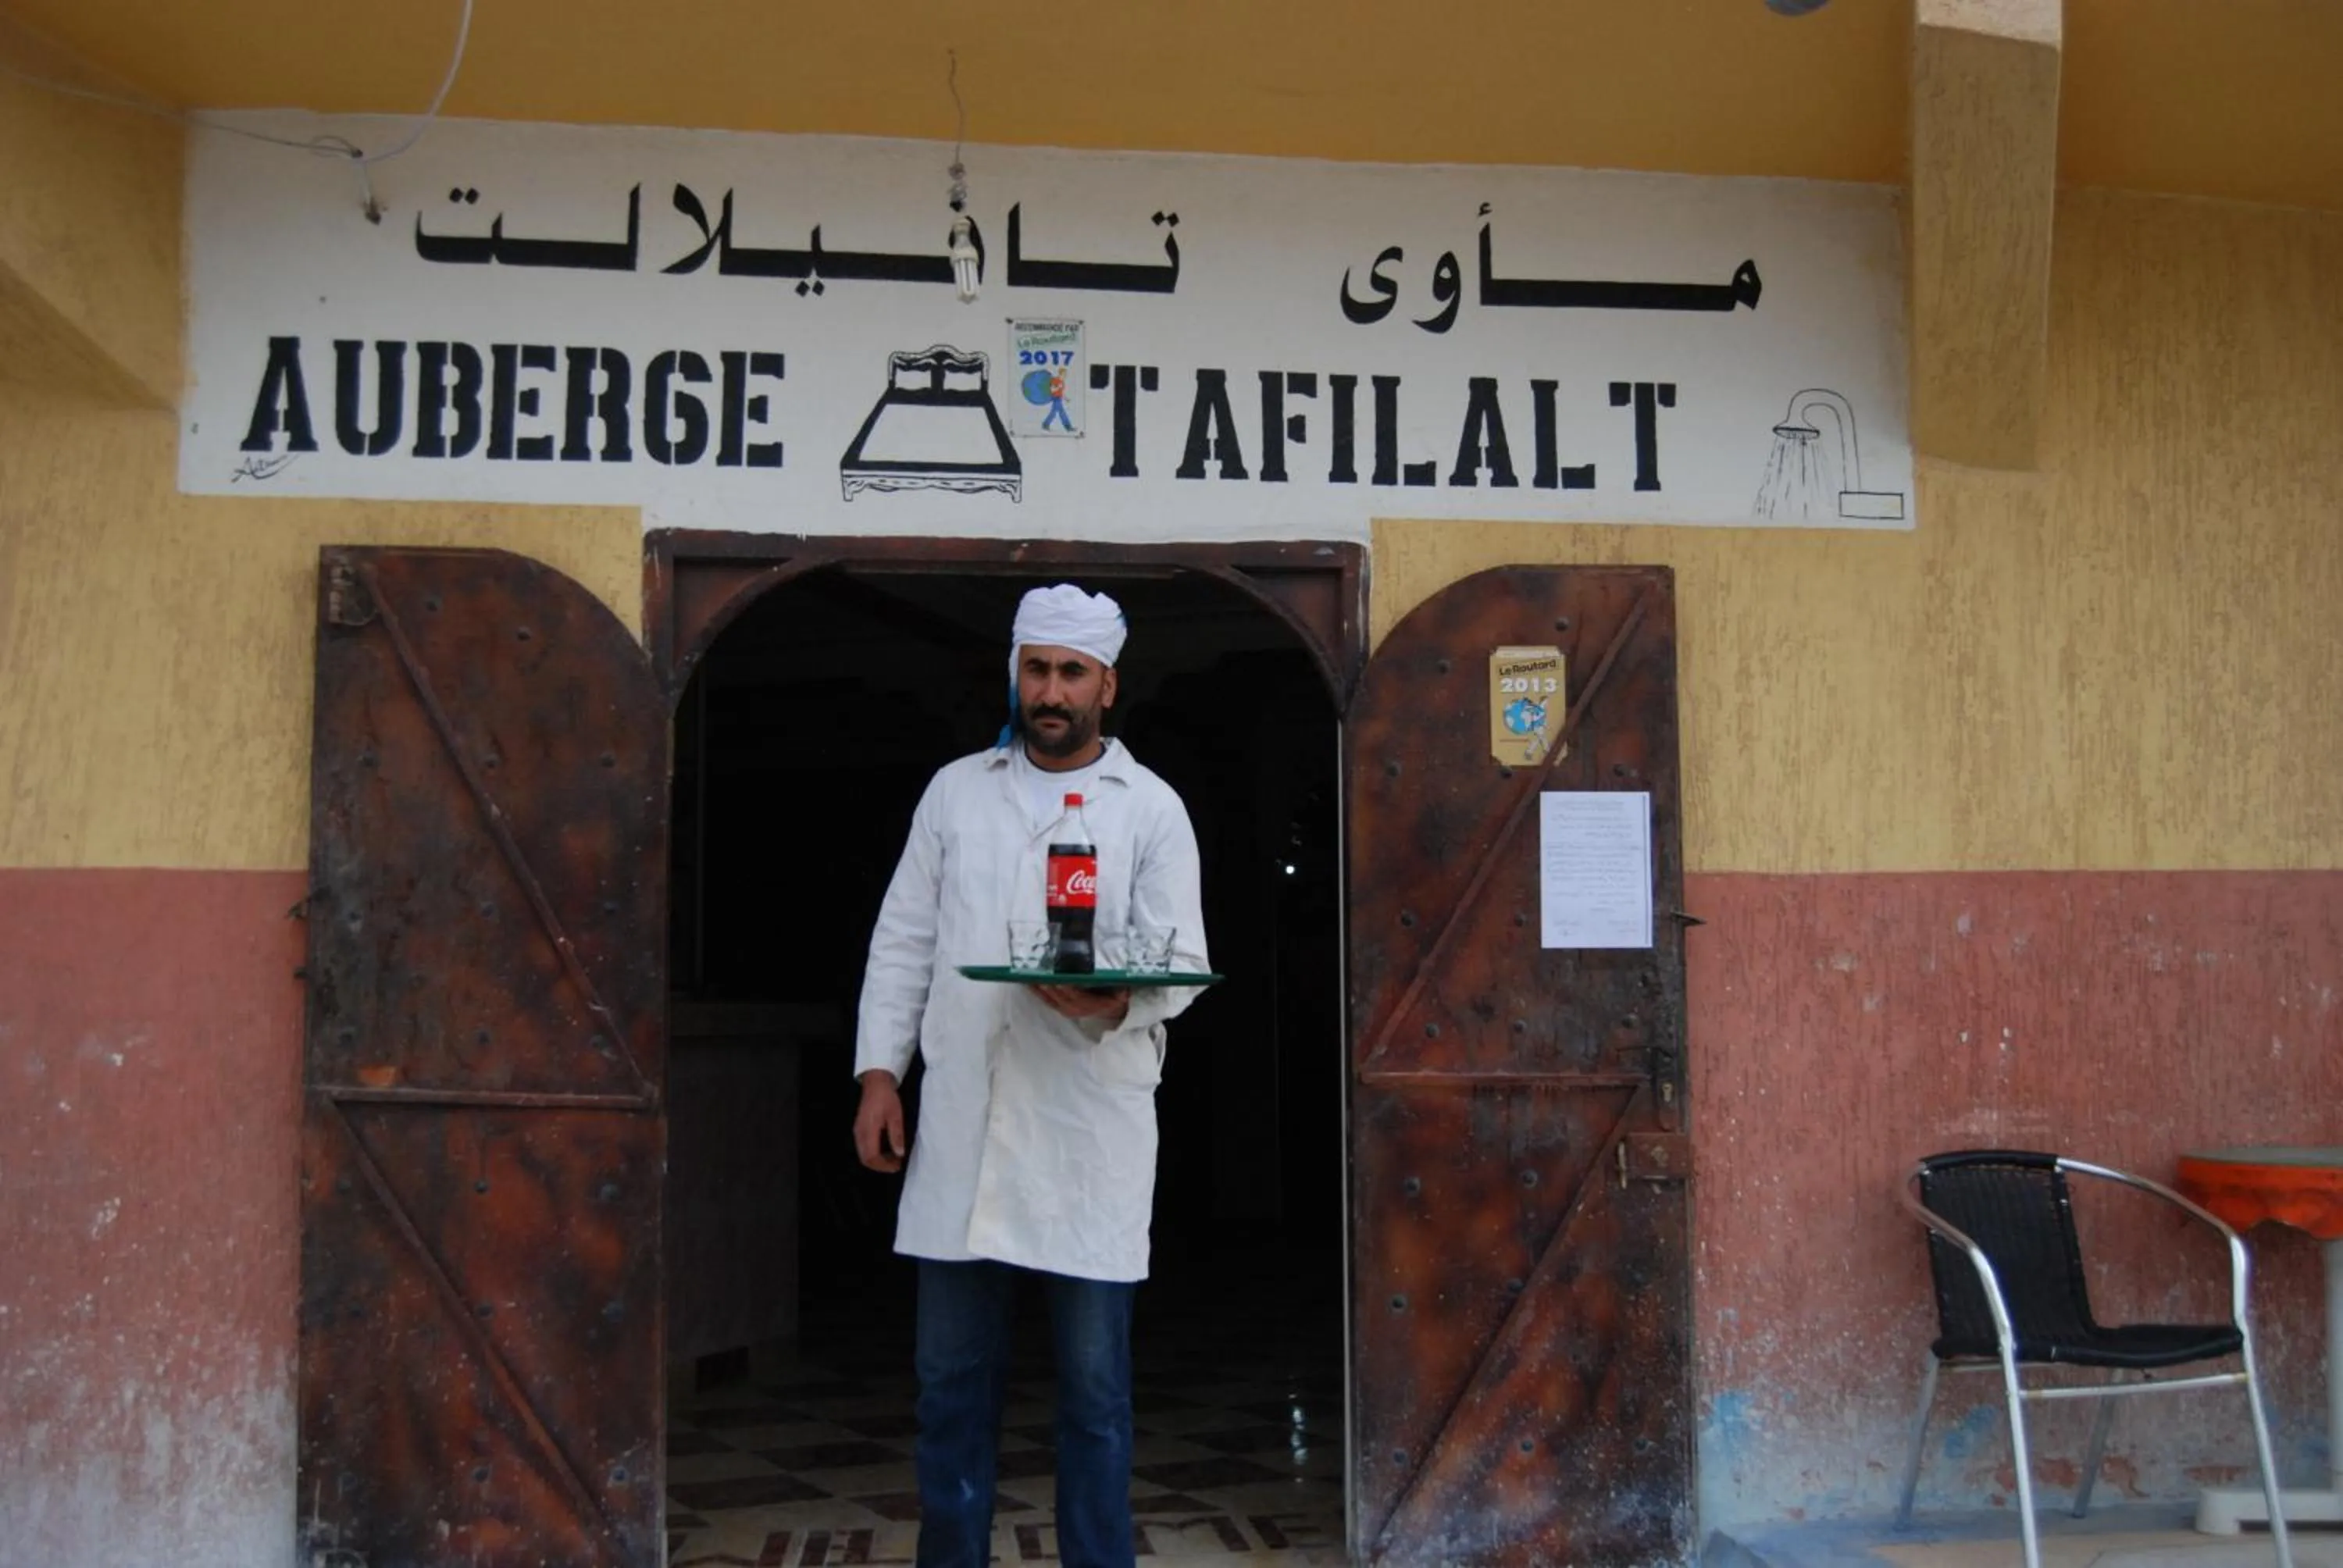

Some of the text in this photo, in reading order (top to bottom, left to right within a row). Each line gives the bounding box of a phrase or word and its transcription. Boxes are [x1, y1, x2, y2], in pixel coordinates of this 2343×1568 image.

[414, 182, 1763, 334] مأوى تافيلالت
[1019, 350, 1075, 366] 2017
[240, 336, 1677, 491] AUBERGE TAFILALT
[1499, 658, 1557, 676] Le Routard
[1500, 676, 1557, 693] 2013
